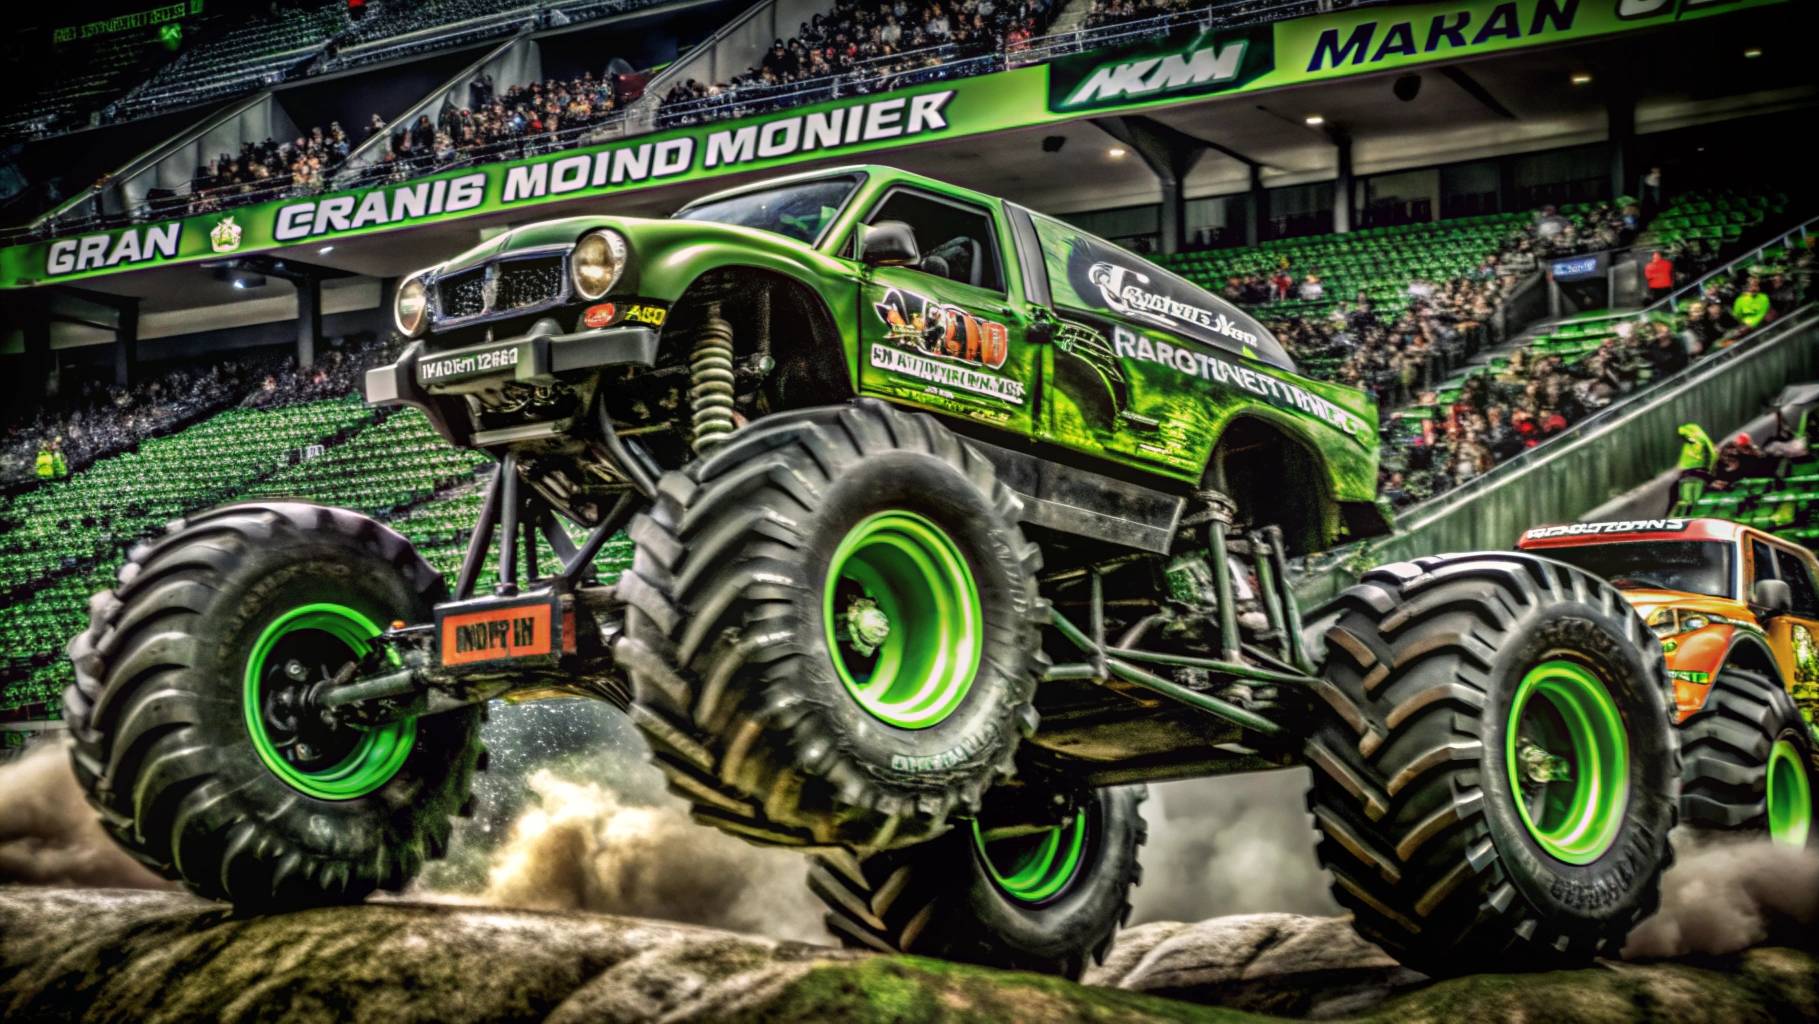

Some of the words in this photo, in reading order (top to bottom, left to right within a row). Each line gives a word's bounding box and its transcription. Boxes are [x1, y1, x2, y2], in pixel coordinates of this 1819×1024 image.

[47, 222, 181, 276] GRAN
[502, 138, 694, 203] MOIND
[704, 90, 955, 168] MONIER
